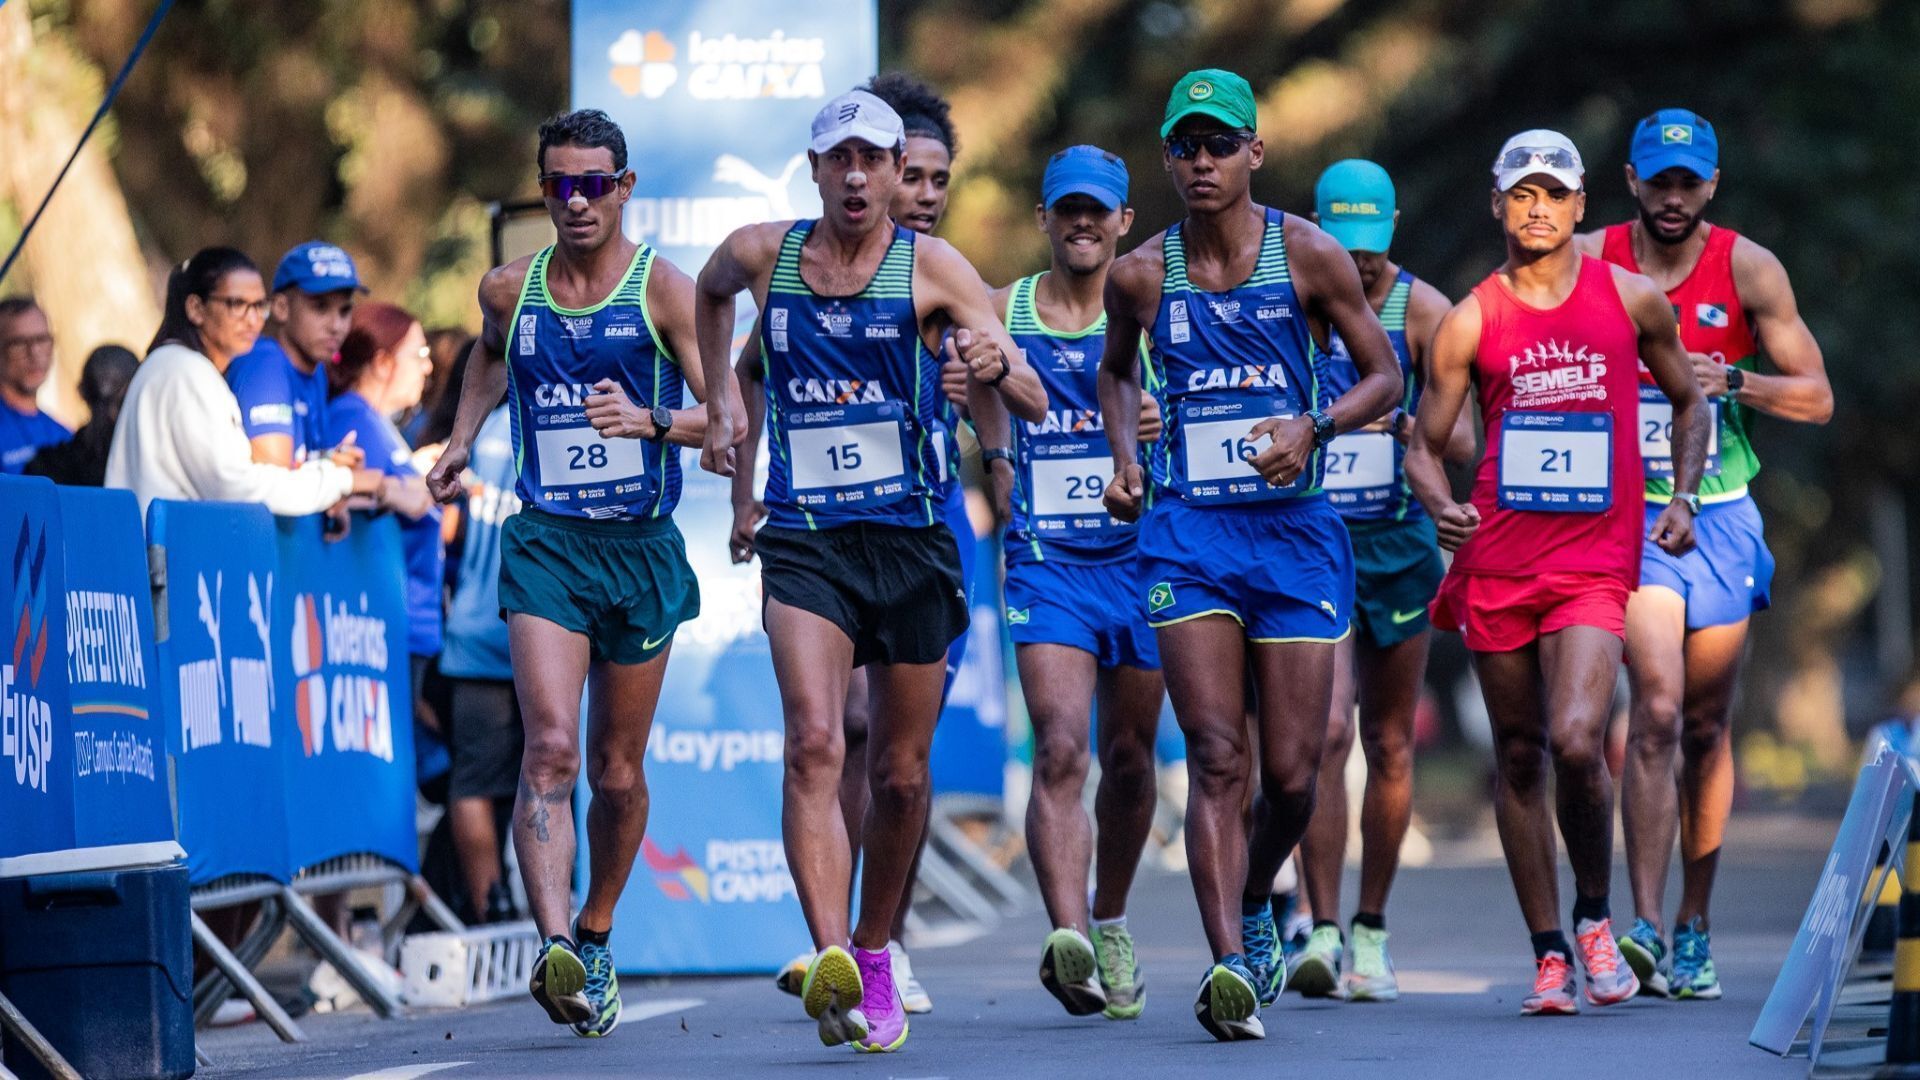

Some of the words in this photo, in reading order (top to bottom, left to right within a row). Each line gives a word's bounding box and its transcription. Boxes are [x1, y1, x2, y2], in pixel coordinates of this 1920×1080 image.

[688, 29, 826, 63] loterias
[688, 64, 826, 98] CAIXA
[1331, 202, 1380, 215] BRASIL
[1256, 308, 1292, 320] BRASIL
[604, 327, 639, 337] BRASIL
[865, 327, 901, 339] BRASIL
[788, 377, 886, 404] CAIXA
[1188, 364, 1288, 391] CAIXA
[1512, 363, 1607, 395] SEMELP
[535, 383, 600, 408] CAI
[1026, 410, 1104, 436] AIX
[567, 443, 608, 471] 28
[826, 442, 862, 471] 15
[1221, 437, 1258, 463] 16
[1326, 452, 1360, 474] 27
[1540, 448, 1572, 473] 21
[1065, 475, 1104, 500] 29
[66, 590, 146, 690] PREFEITURA
[323, 590, 388, 672] loterias
[331, 672, 394, 764] CAIXA
[652, 722, 785, 772] laypis
[712, 871, 799, 902] CAMP
